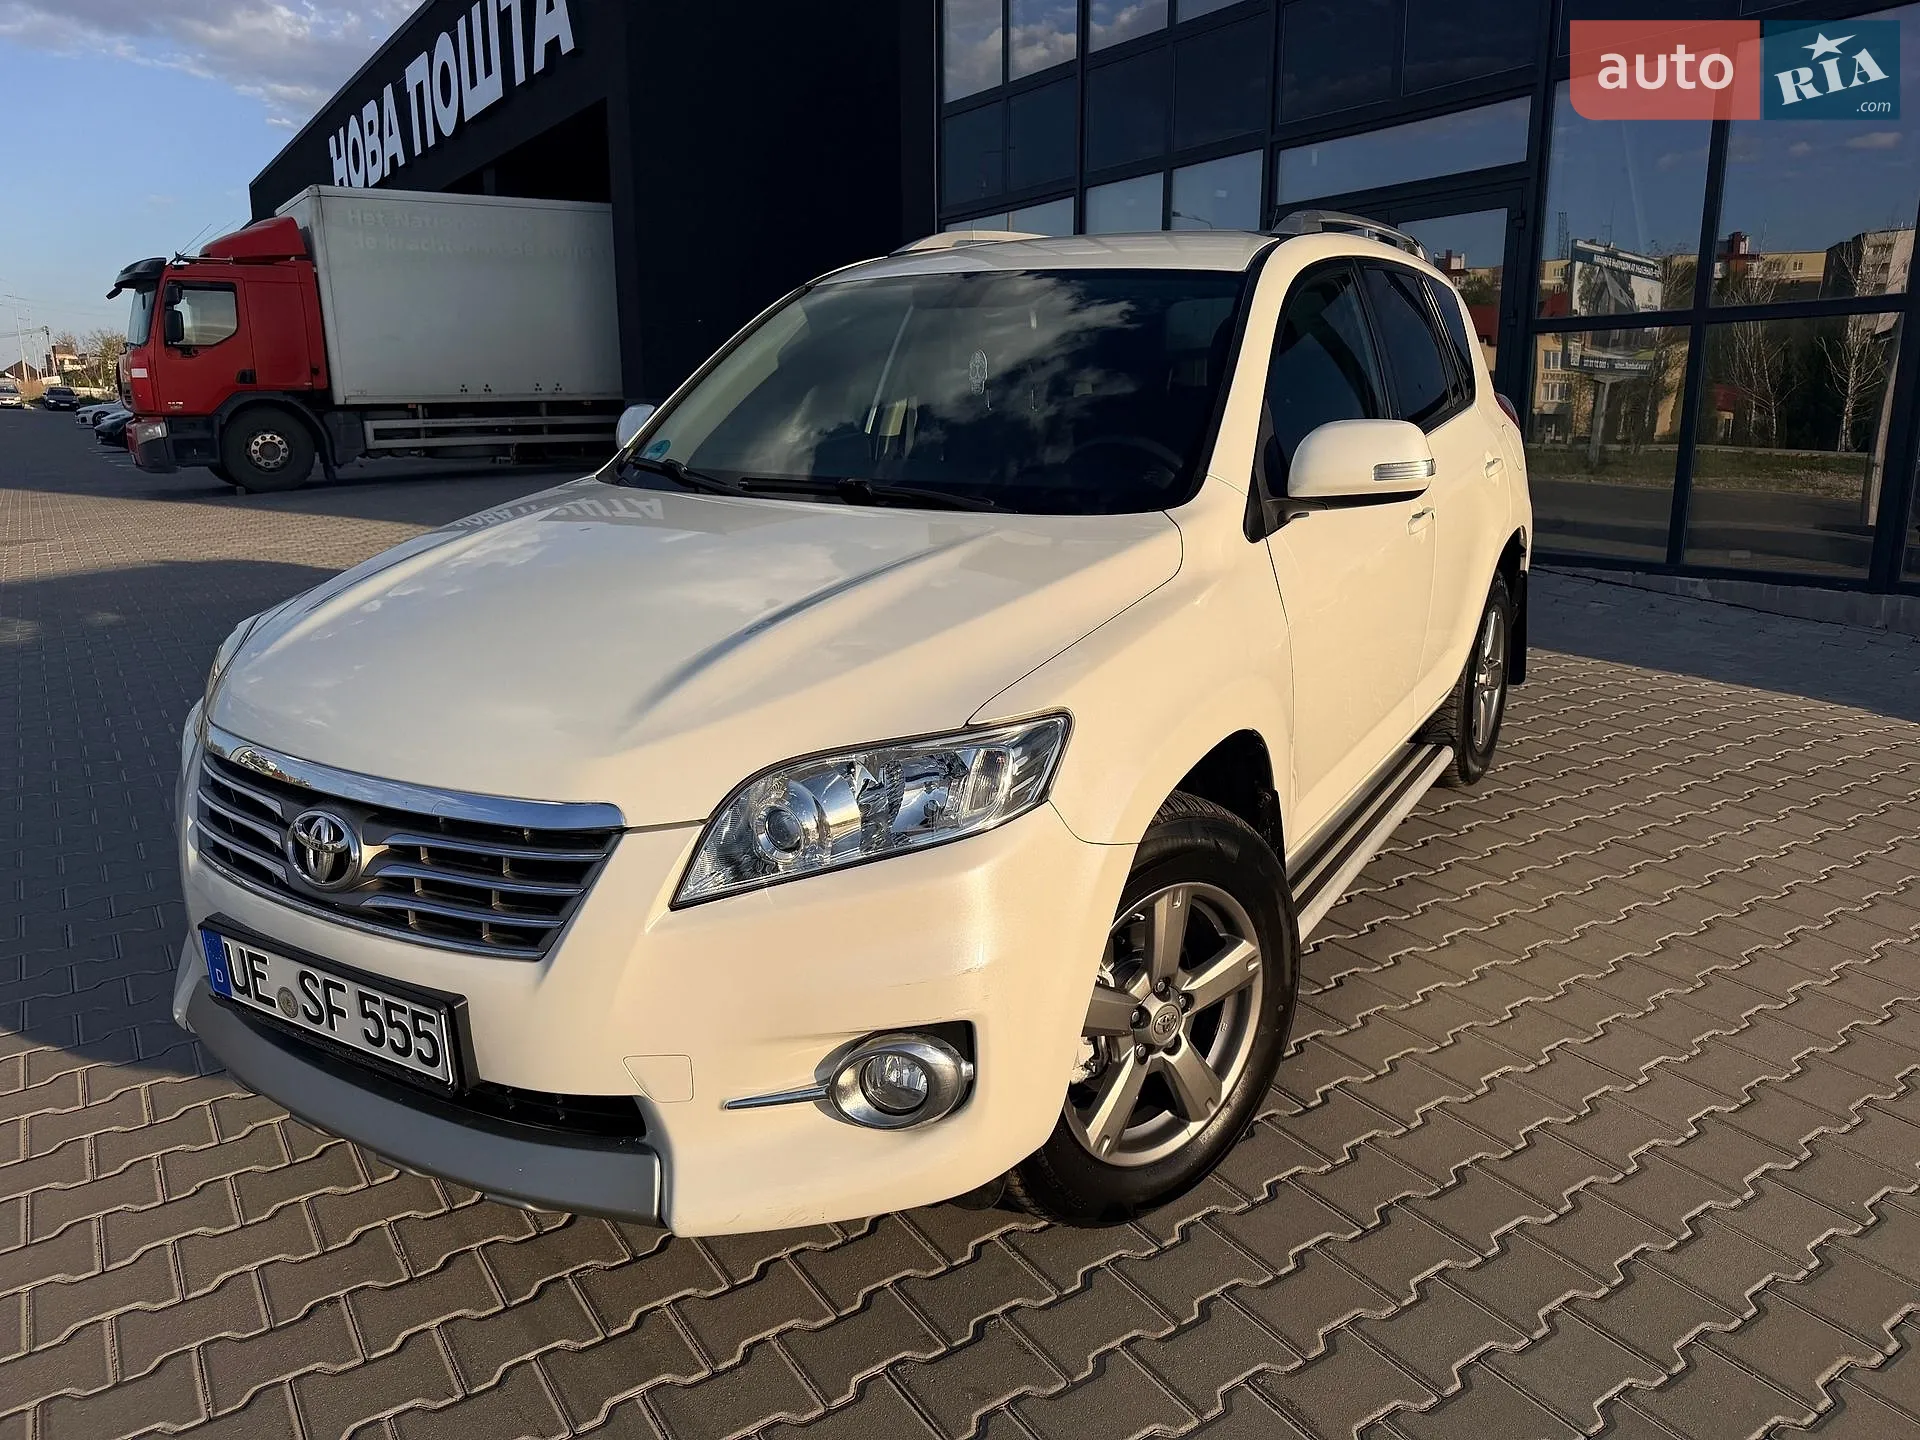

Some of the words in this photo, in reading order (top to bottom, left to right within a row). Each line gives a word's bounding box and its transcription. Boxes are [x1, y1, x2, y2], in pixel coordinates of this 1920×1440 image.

[329, 83, 405, 187] НОВА
[405, 0, 575, 157] ПОШТА
[215, 968, 224, 983] D
[223, 941, 278, 1009] UE
[298, 969, 349, 1033] SF
[357, 987, 441, 1068] 555
